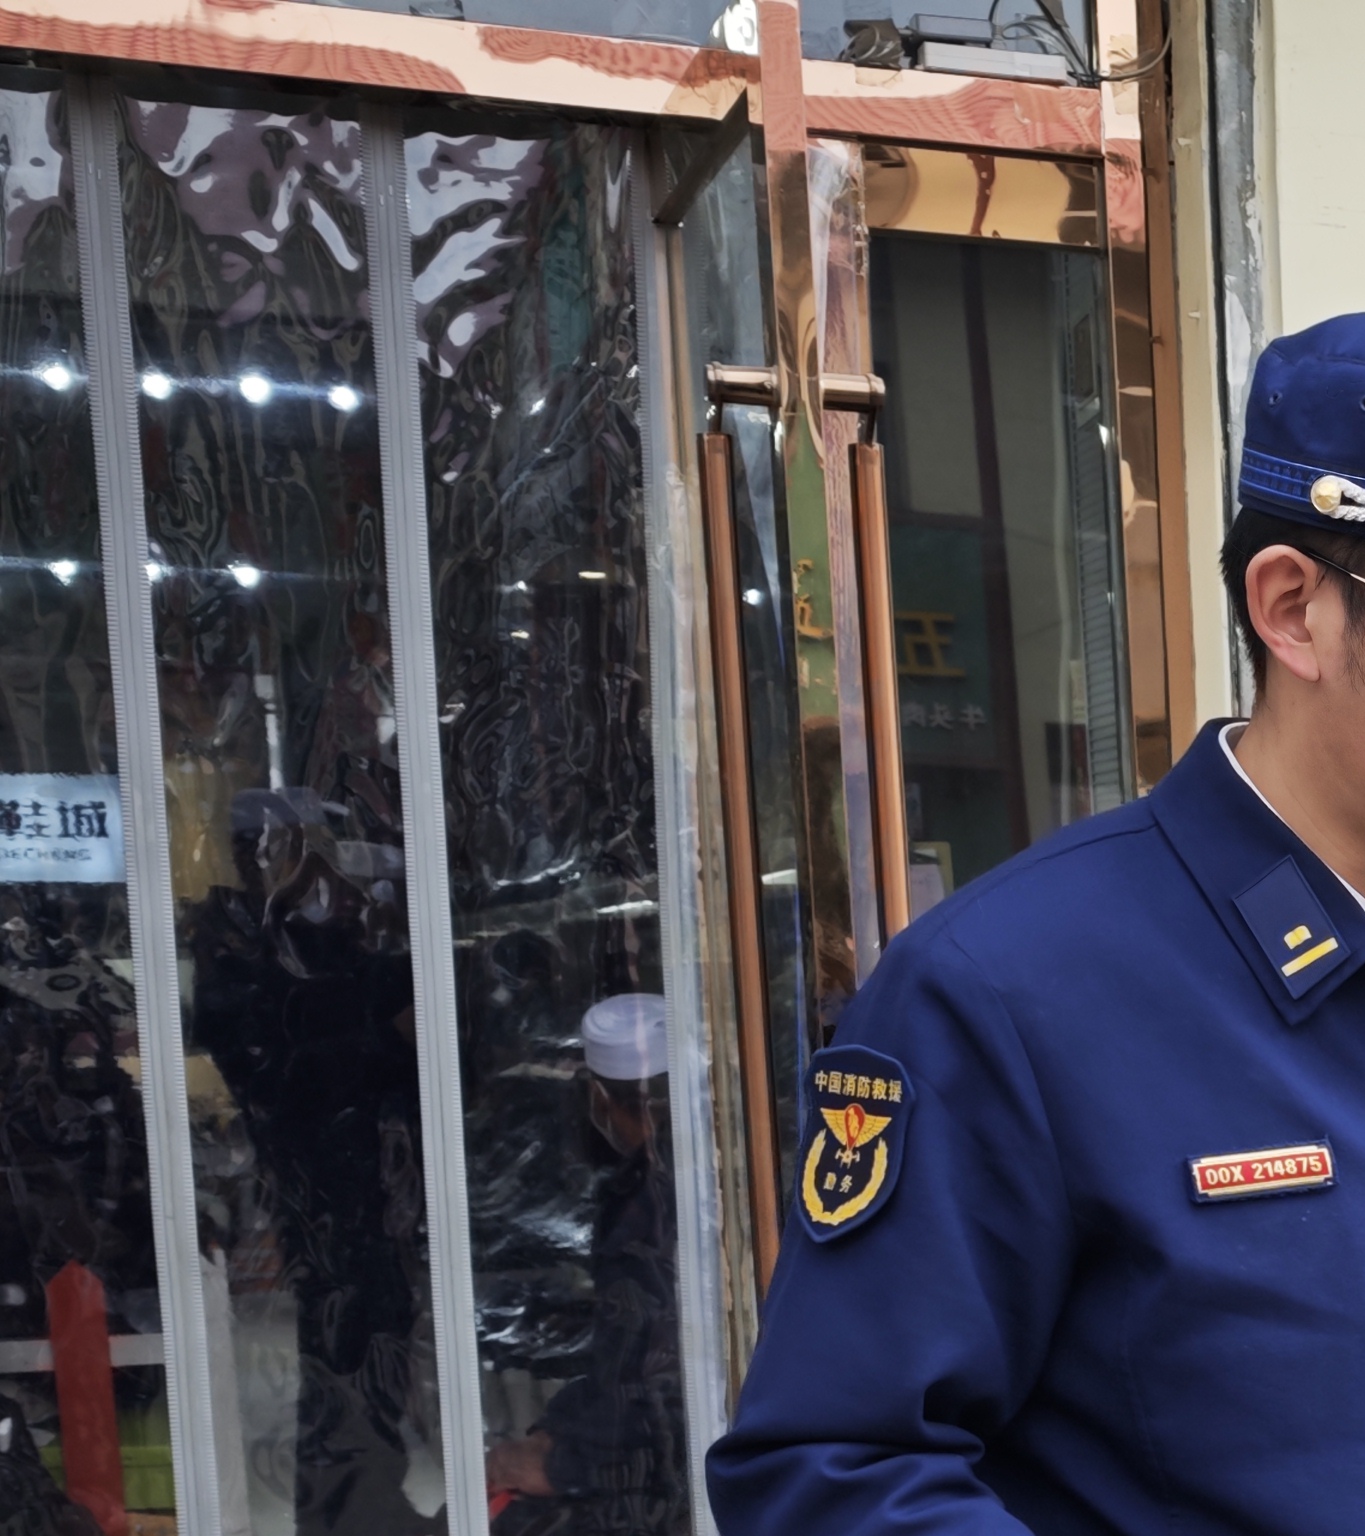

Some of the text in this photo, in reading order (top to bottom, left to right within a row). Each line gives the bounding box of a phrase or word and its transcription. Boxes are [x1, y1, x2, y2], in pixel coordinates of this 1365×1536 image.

[814, 1070, 903, 1103] 中国消防救援
[1251, 1155, 1323, 1180] 214875
